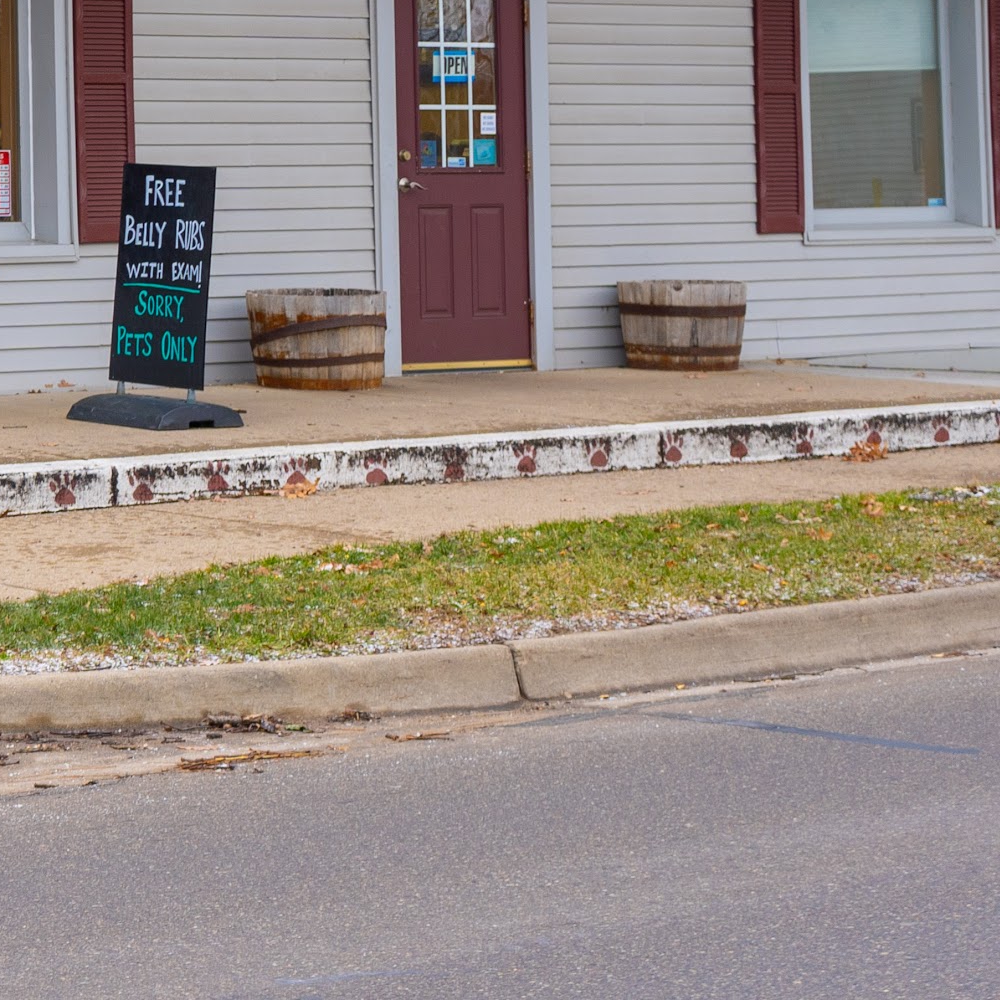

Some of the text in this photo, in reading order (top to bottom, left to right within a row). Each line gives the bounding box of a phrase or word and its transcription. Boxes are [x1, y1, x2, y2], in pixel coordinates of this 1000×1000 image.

[144, 174, 186, 208] FREE
[123, 214, 206, 251] BELLY RUBS
[126, 260, 203, 289] WITH EXAM!
[134, 289, 185, 323] SORRY,
[116, 325, 198, 363] PETS ONLY
